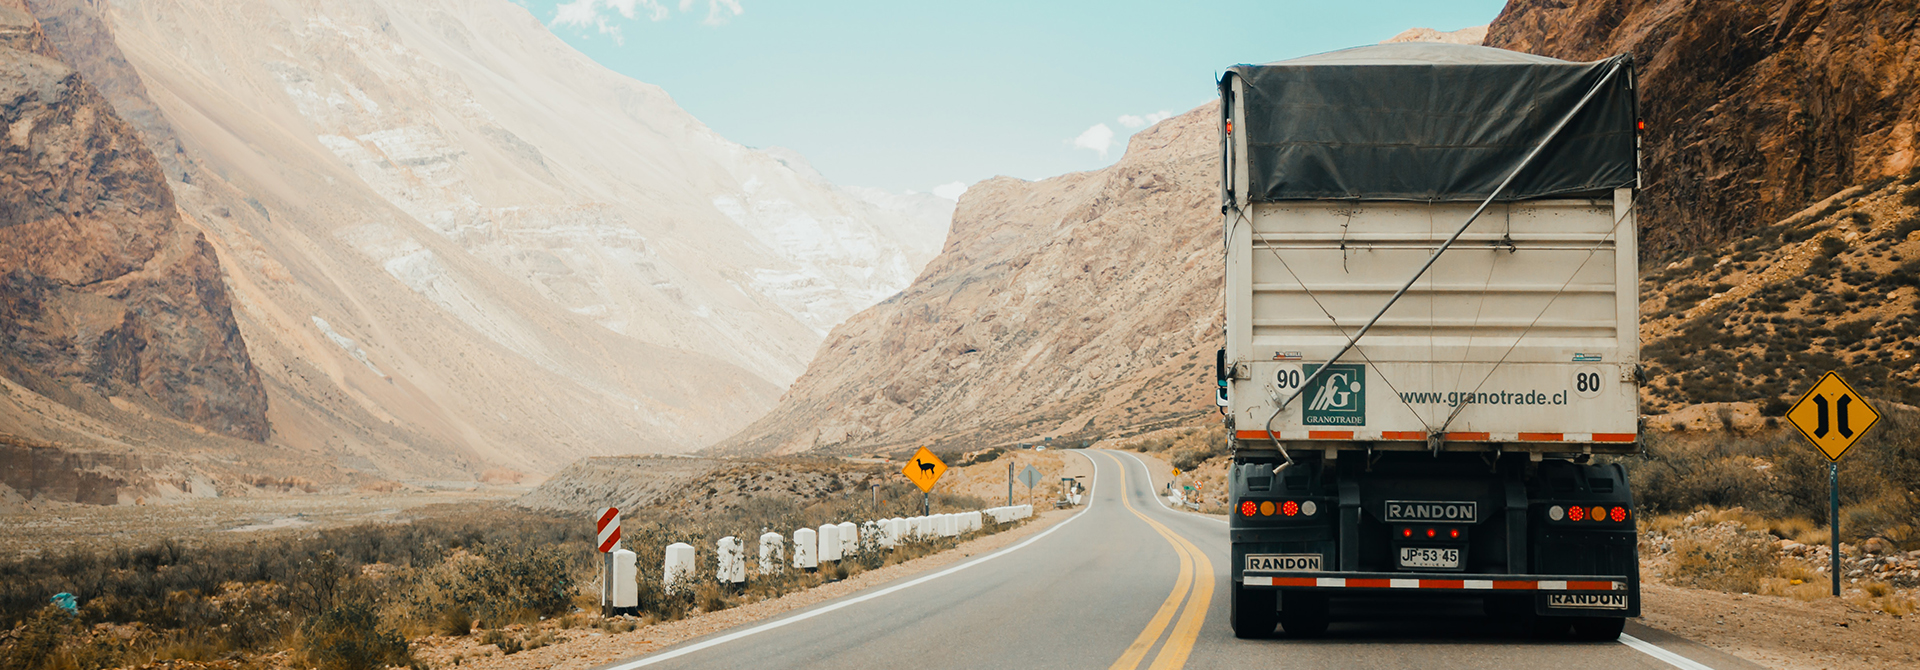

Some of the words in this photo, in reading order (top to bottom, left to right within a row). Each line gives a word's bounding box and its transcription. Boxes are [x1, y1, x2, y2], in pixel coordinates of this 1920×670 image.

[1277, 369, 1300, 389] 90
[1577, 372, 1600, 392] 80
[1400, 389, 1567, 407] www.granotrade.cl
[1306, 415, 1362, 424] GRANOTRADE
[1389, 504, 1473, 519] RANDON
[1250, 558, 1319, 570] RANDON
[1552, 594, 1623, 605] RANDON
